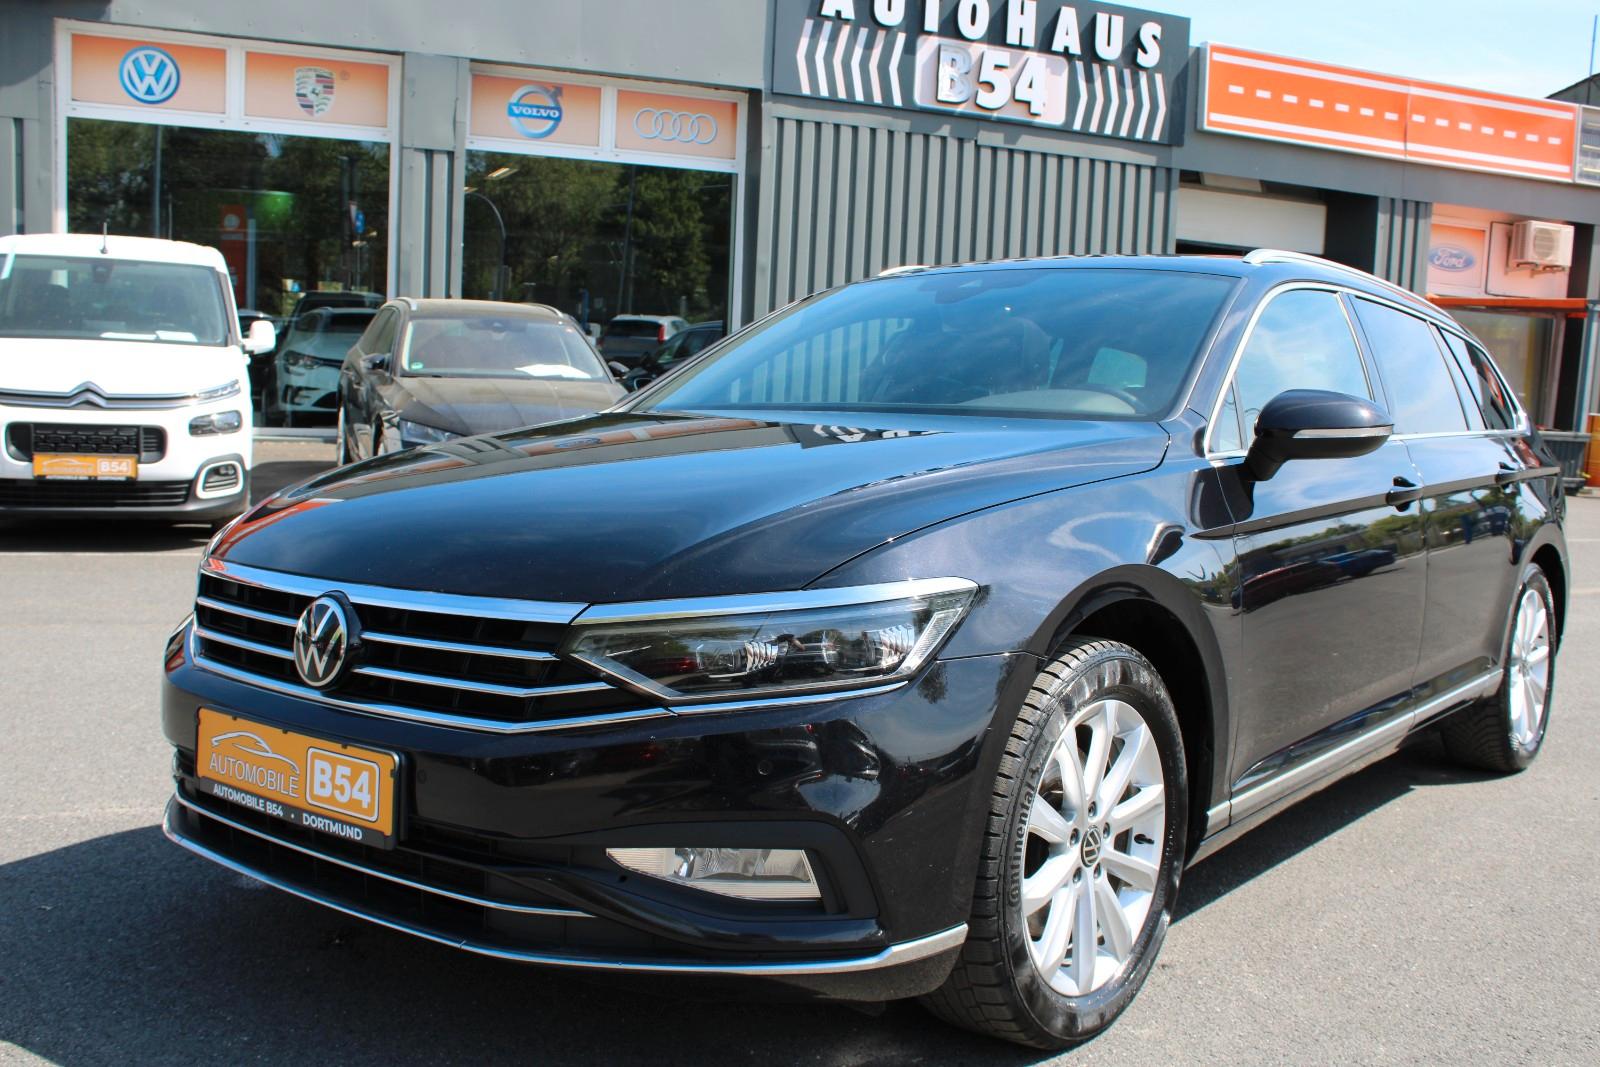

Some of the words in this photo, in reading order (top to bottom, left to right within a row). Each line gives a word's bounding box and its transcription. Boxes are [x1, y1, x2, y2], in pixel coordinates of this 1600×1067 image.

[936, 44, 1048, 117] B54
[511, 105, 560, 118] VOLVO
[1433, 247, 1466, 267] Ford
[99, 460, 129, 472] B54
[210, 752, 300, 798] AUTOMOBILE
[313, 759, 371, 809] B54
[212, 783, 265, 811] AUTOMOBILE
[266, 802, 284, 818] B54
[302, 812, 363, 841] DORTMUND
